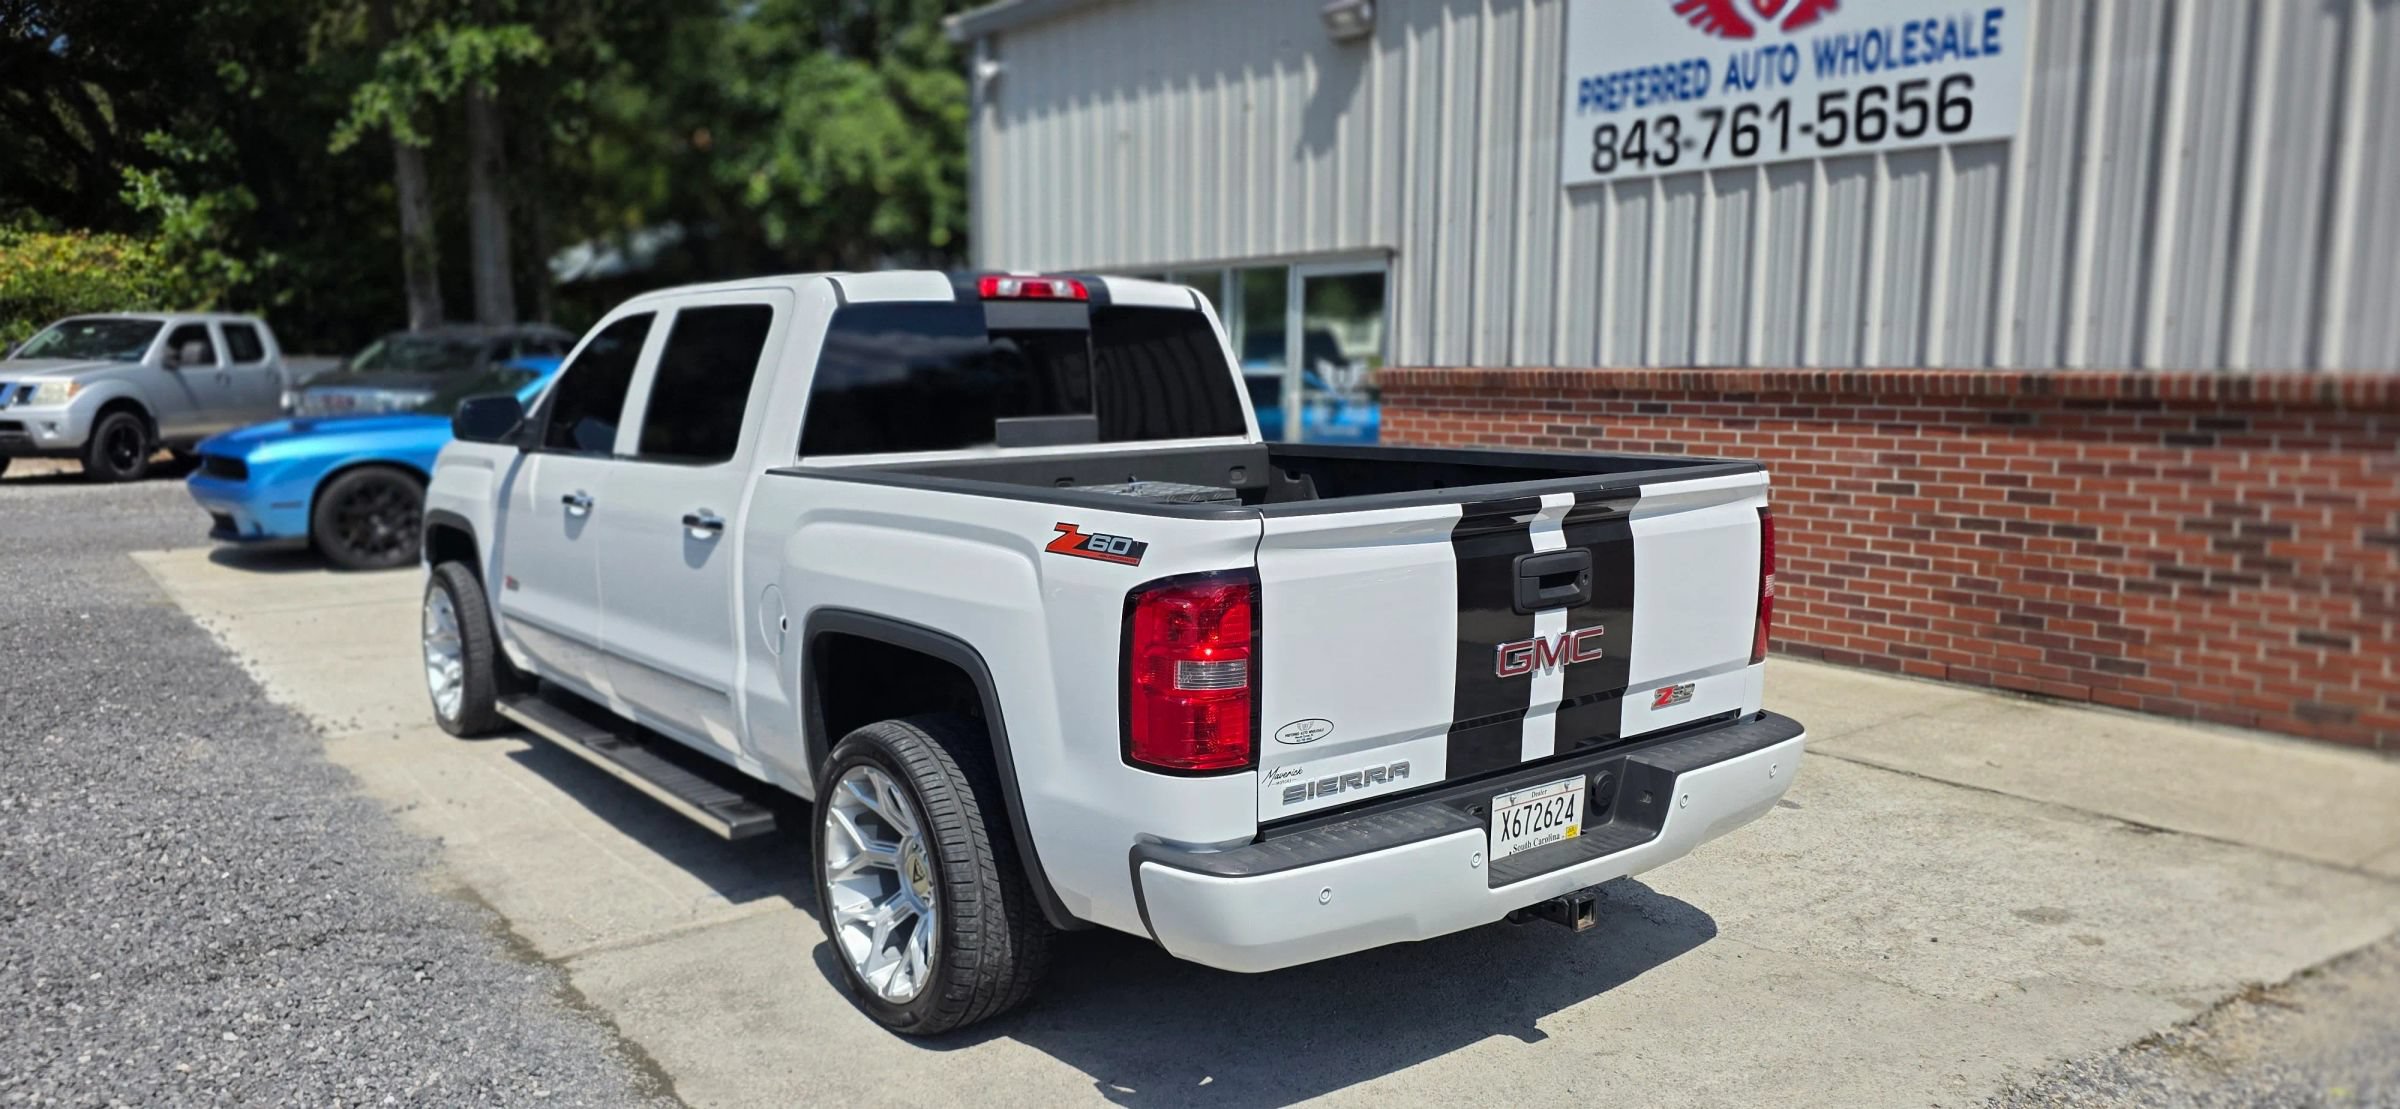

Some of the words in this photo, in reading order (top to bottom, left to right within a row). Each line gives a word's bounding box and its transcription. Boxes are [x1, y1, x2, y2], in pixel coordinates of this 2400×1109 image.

[1577, 58, 1711, 114] PREFERRED
[1722, 43, 1800, 93] AUTO
[1812, 10, 2004, 80] WHOLESALE
[1591, 73, 1975, 174] 843-761-5656
[1044, 522, 1134, 558] Z60
[1496, 625, 1604, 678] GMC
[1283, 761, 1410, 805] SIERRA
[1531, 789, 1548, 798] Dealer
[1501, 793, 1575, 842] X672624
[1513, 840, 1532, 853] South
[1533, 832, 1560, 847] Carolina
